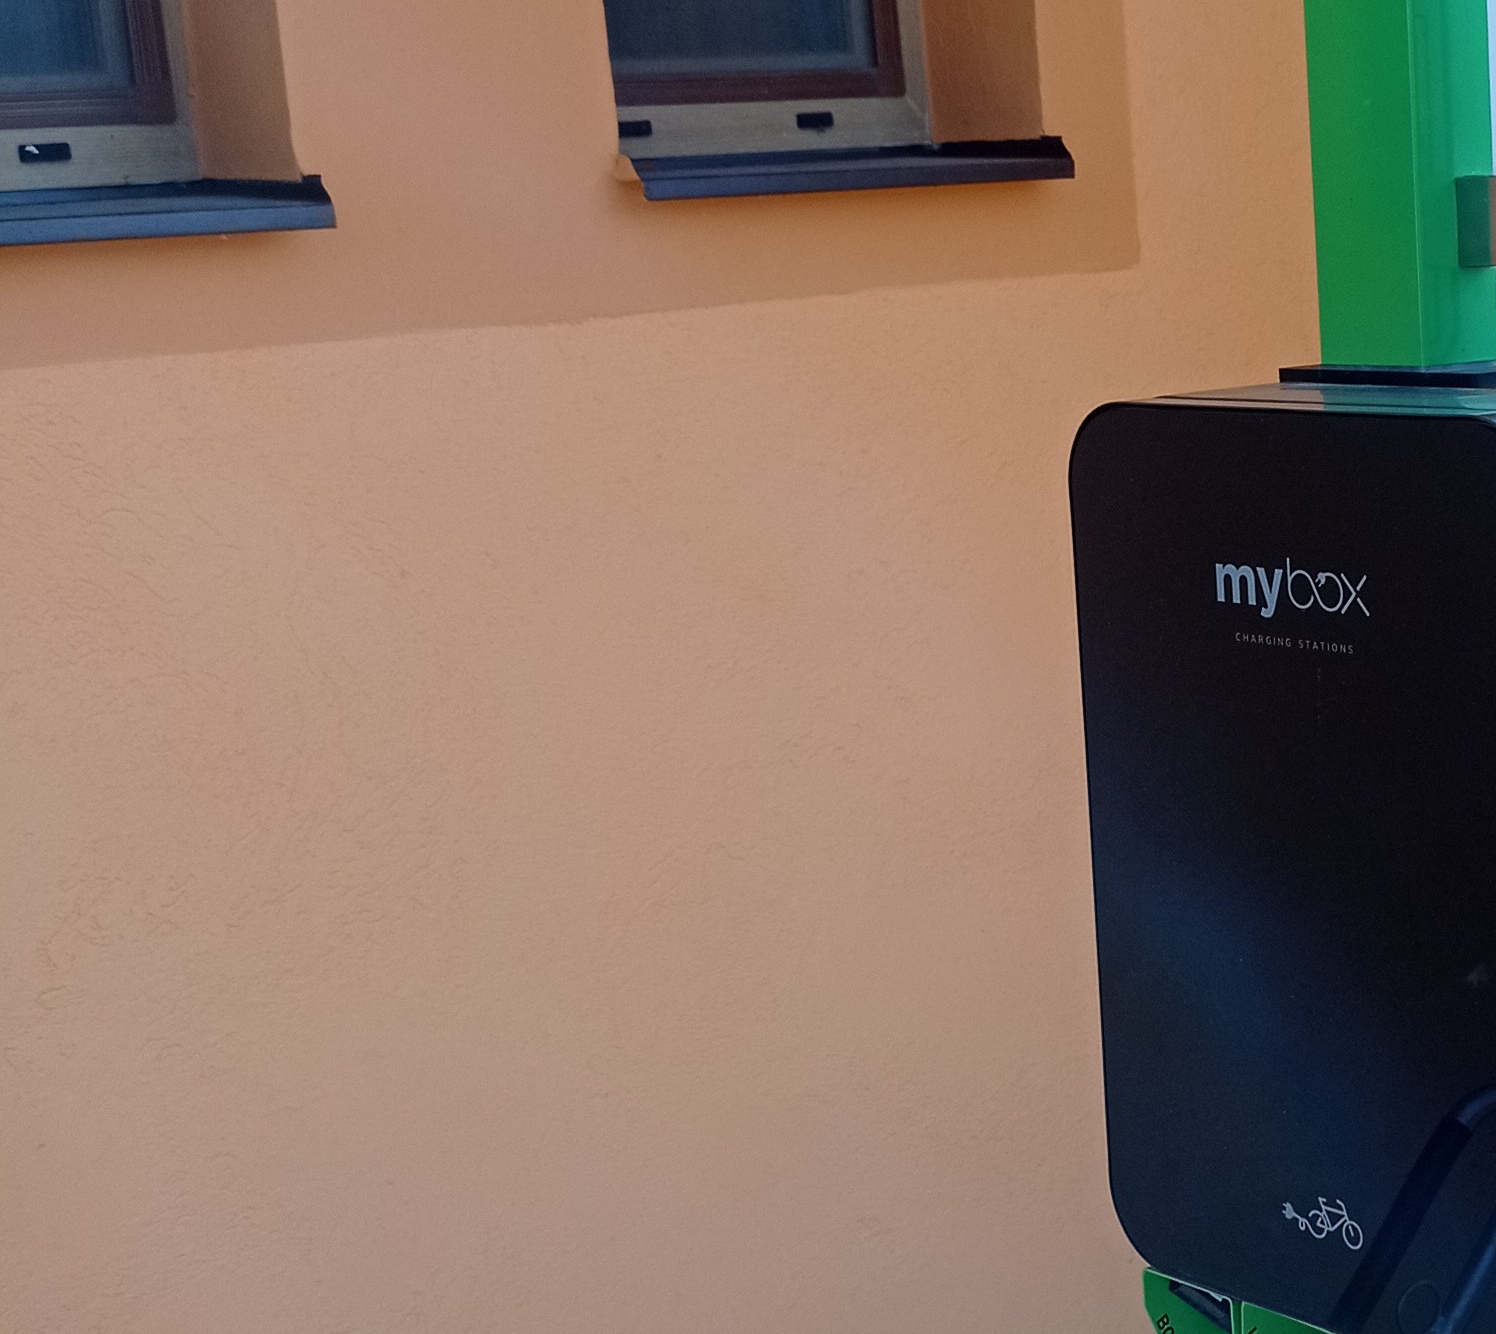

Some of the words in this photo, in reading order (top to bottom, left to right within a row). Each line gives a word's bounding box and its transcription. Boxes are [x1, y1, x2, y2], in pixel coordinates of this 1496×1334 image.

[1215, 557, 1370, 618] mybox
[1235, 632, 1292, 648] CHARGING
[1299, 639, 1354, 654] STATIONS
